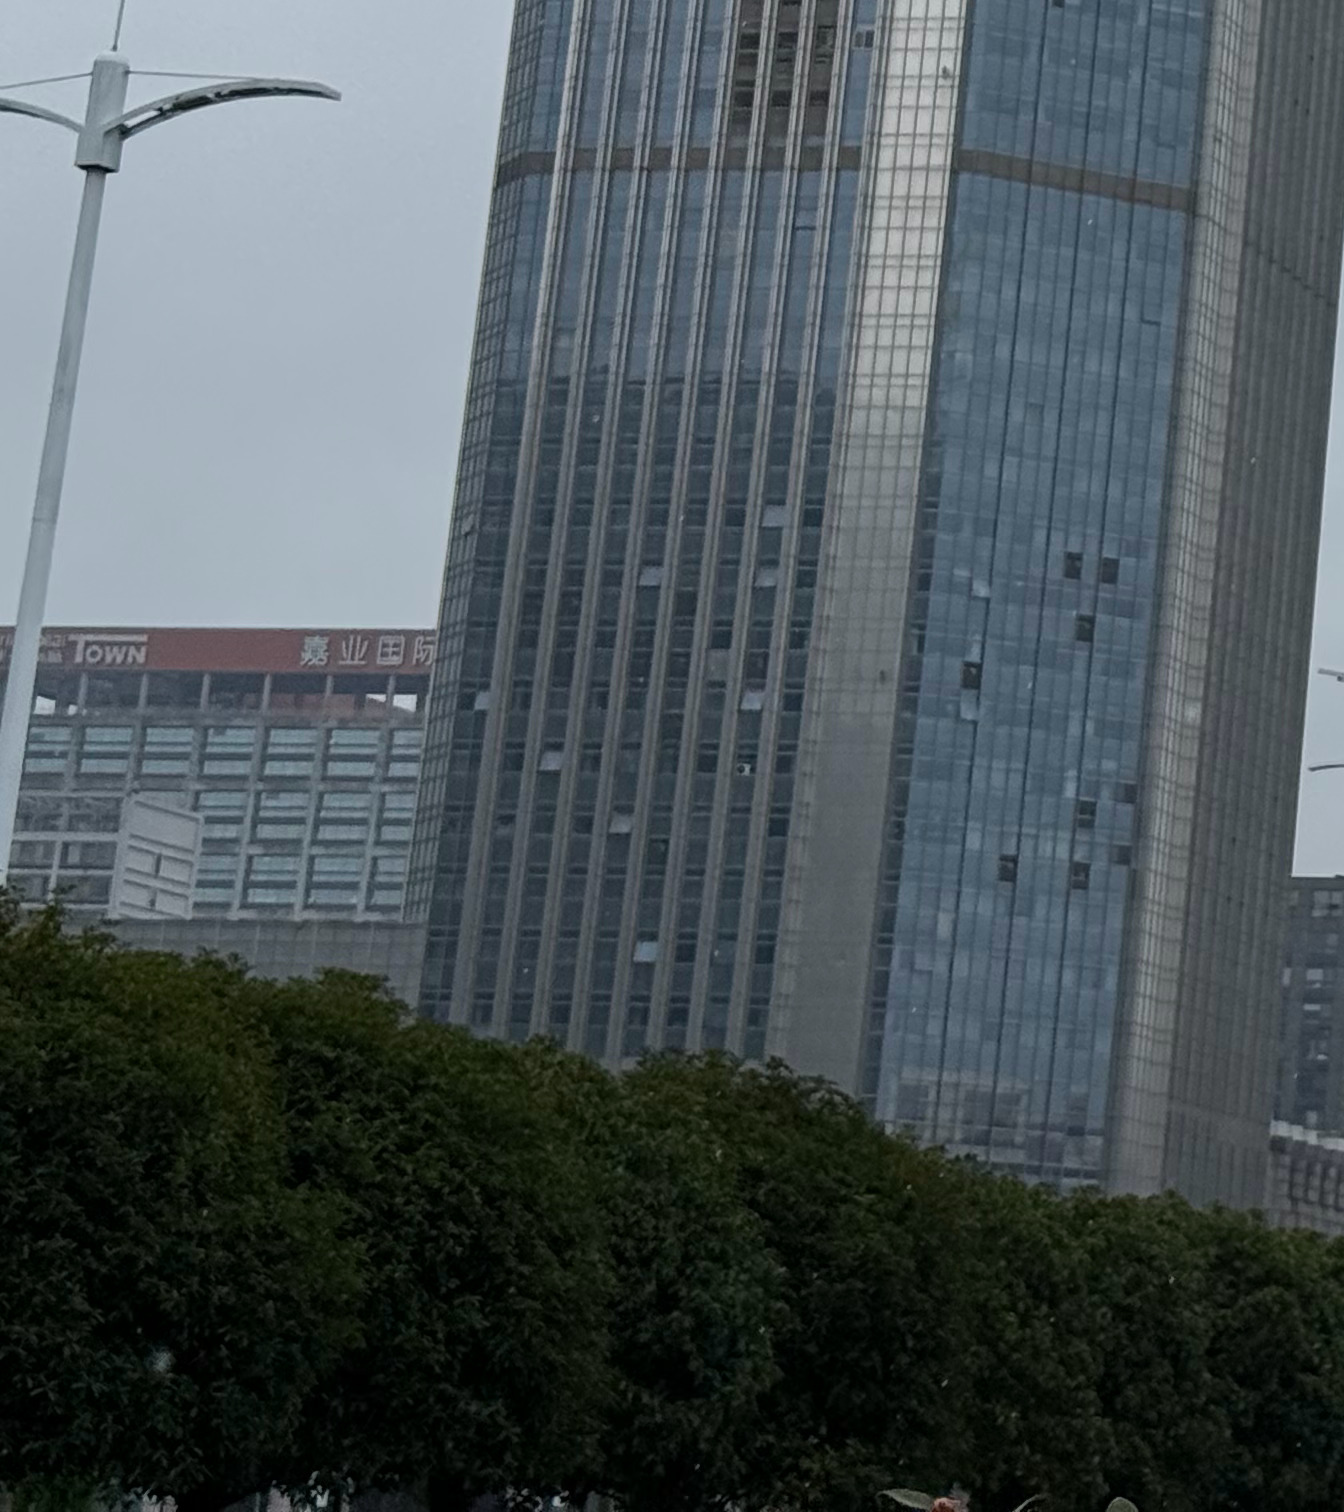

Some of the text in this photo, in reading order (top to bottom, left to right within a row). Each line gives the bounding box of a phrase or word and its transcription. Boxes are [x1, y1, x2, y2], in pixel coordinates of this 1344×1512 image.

[68, 634, 148, 664] TOWN
[300, 634, 434, 666] 嘉业国际
